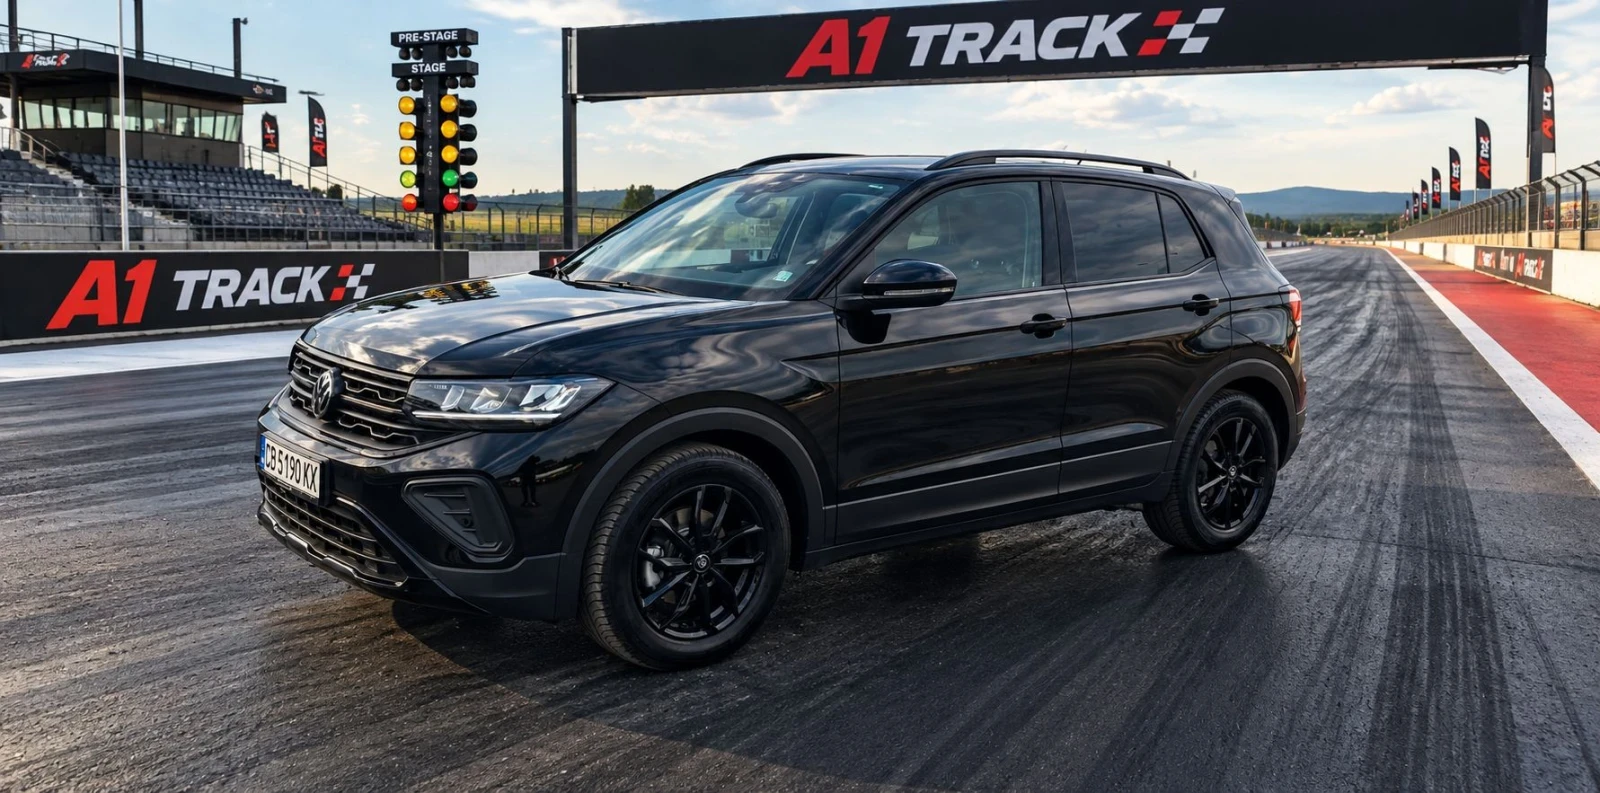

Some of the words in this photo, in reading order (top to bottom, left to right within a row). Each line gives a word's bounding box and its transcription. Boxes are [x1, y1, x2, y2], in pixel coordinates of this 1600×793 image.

[398, 30, 458, 43] PRE-STAGE
[785, 16, 891, 78] A1
[905, 12, 1142, 67] TRACK
[411, 62, 446, 73] STAGE
[45, 259, 157, 330] A1
[173, 265, 331, 311] TRACK
[265, 443, 277, 471] CB
[278, 449, 302, 484] 5190
[303, 462, 318, 493] KX
